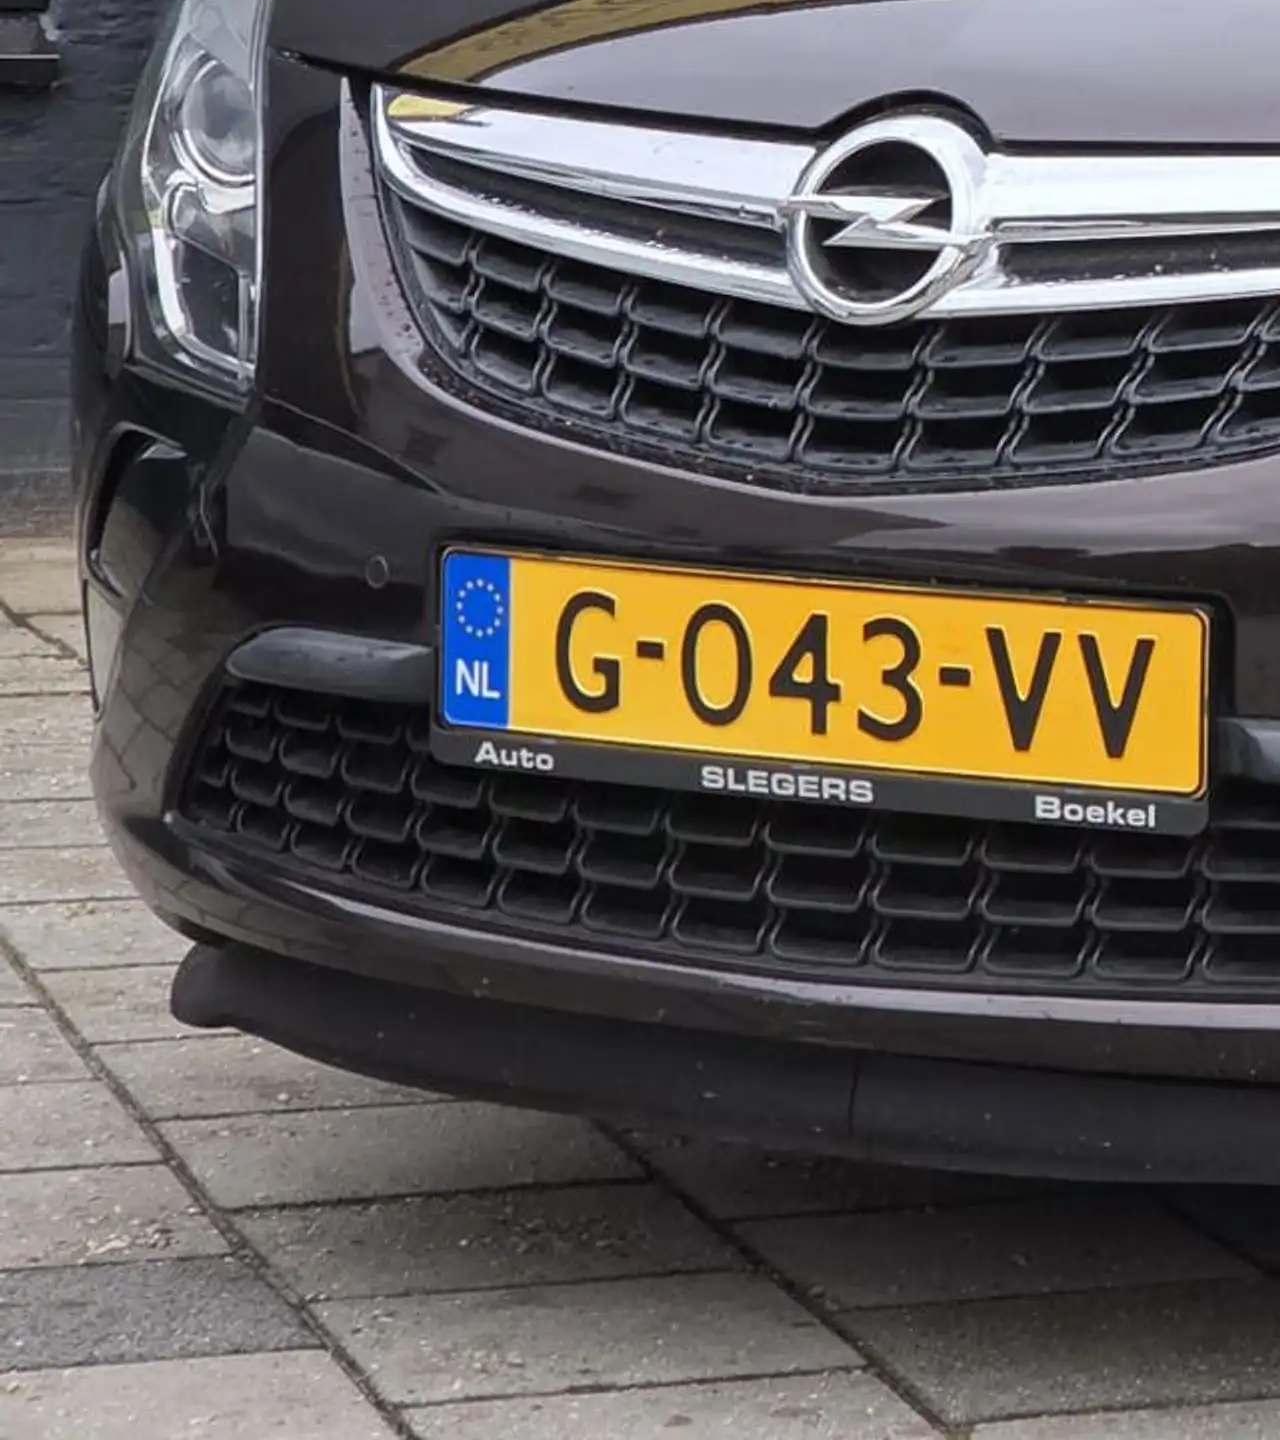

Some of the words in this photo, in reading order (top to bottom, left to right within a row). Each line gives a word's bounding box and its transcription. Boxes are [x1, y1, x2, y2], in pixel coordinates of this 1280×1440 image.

[455, 658, 500, 699] NL
[552, 589, 1156, 758] G-043-VV
[474, 740, 555, 772] Auto
[700, 766, 874, 804] SLEGERS
[1034, 795, 1156, 829] Boekel
